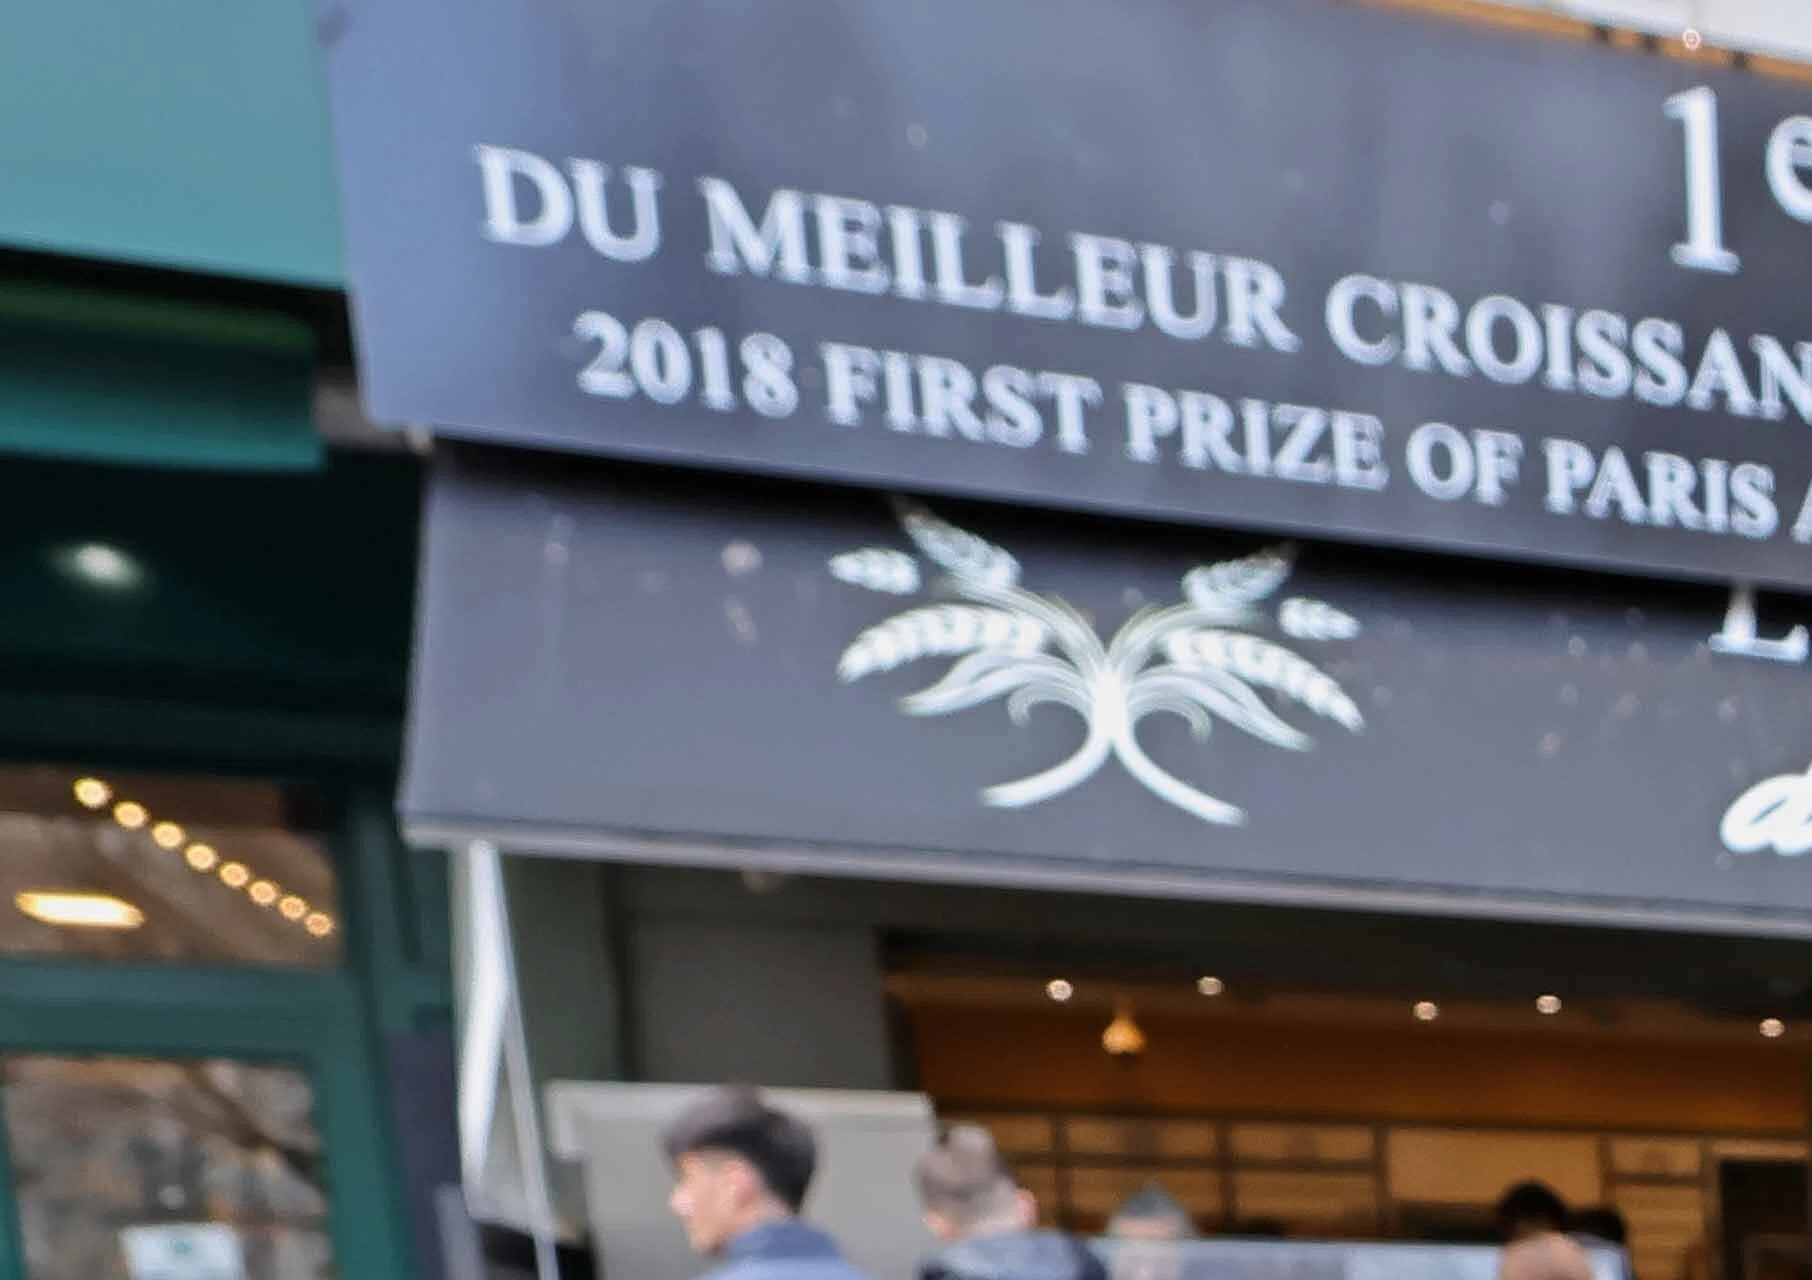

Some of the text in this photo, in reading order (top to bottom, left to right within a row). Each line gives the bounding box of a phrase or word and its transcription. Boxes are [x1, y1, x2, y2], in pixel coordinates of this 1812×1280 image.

[475, 146, 661, 261] DU
[701, 177, 1299, 353] MEILLEUR
[574, 311, 797, 419] 2018
[820, 342, 1101, 456] FIRST
[1125, 380, 1389, 492] PRIZE
[1406, 421, 1521, 506] OF
[1544, 439, 1778, 541] PARIS
